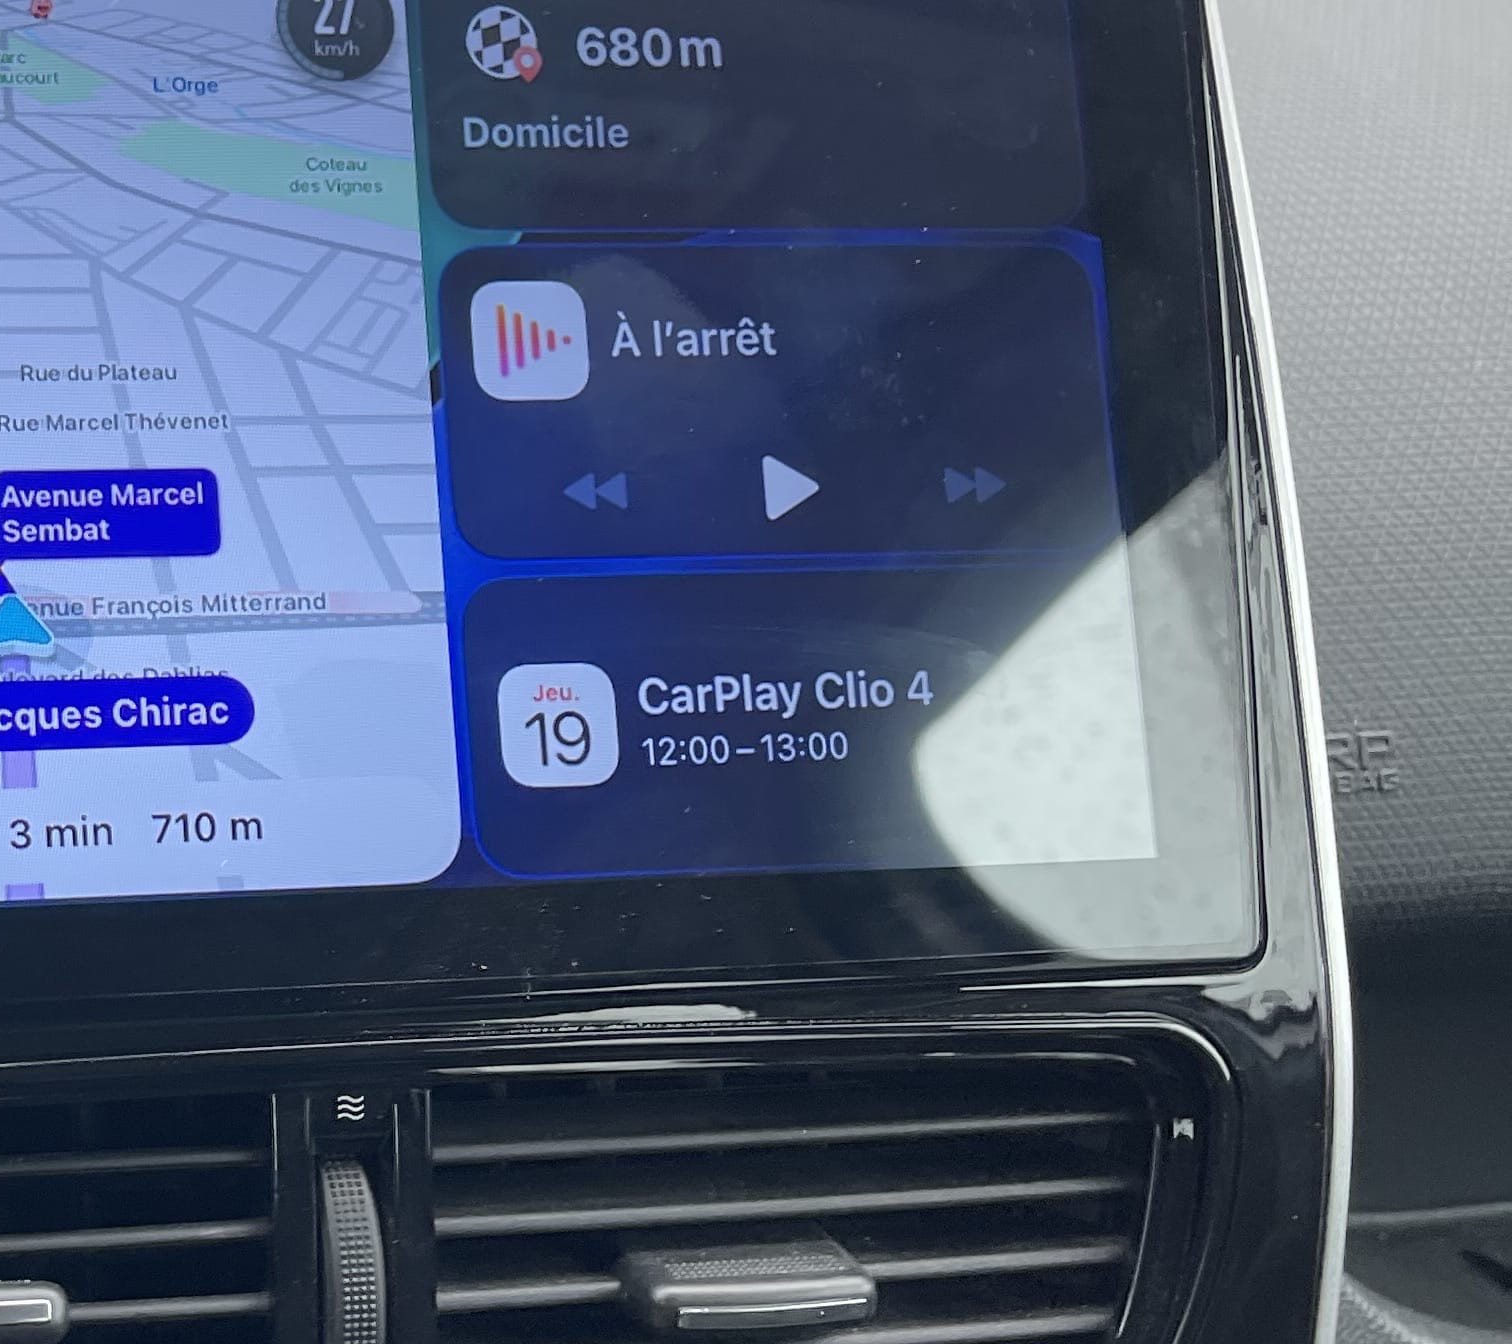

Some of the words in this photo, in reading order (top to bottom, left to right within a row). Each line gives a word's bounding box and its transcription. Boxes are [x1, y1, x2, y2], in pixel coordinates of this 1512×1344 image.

[314, 39, 360, 57] km/h
[153, 77, 218, 96] L'Orge
[463, 115, 629, 149] Domicile
[306, 157, 367, 172] Coteau
[290, 178, 321, 193] des
[325, 178, 383, 196] Vignes
[611, 312, 641, 357] À
[20, 365, 60, 382] Rue
[67, 365, 93, 382] du
[98, 364, 178, 381] Plateau
[47, 413, 119, 431] Marcel
[125, 412, 228, 430] Thévenet
[2, 484, 104, 509] Avenue
[111, 482, 204, 506] Marcel
[3, 519, 110, 542] Sembat
[29, 600, 84, 616] enue
[92, 595, 193, 620] François
[201, 593, 326, 614] Mitterrand
[533, 684, 580, 703] Jeu.
[638, 673, 802, 719] CarPlay
[814, 671, 895, 711] Clio
[907, 671, 934, 707] 4
[113, 696, 229, 726] Chirac
[525, 711, 591, 766] 19
[9, 819, 32, 849] 3
[45, 816, 114, 847] min
[152, 813, 216, 843] 710
[231, 817, 263, 841] m
